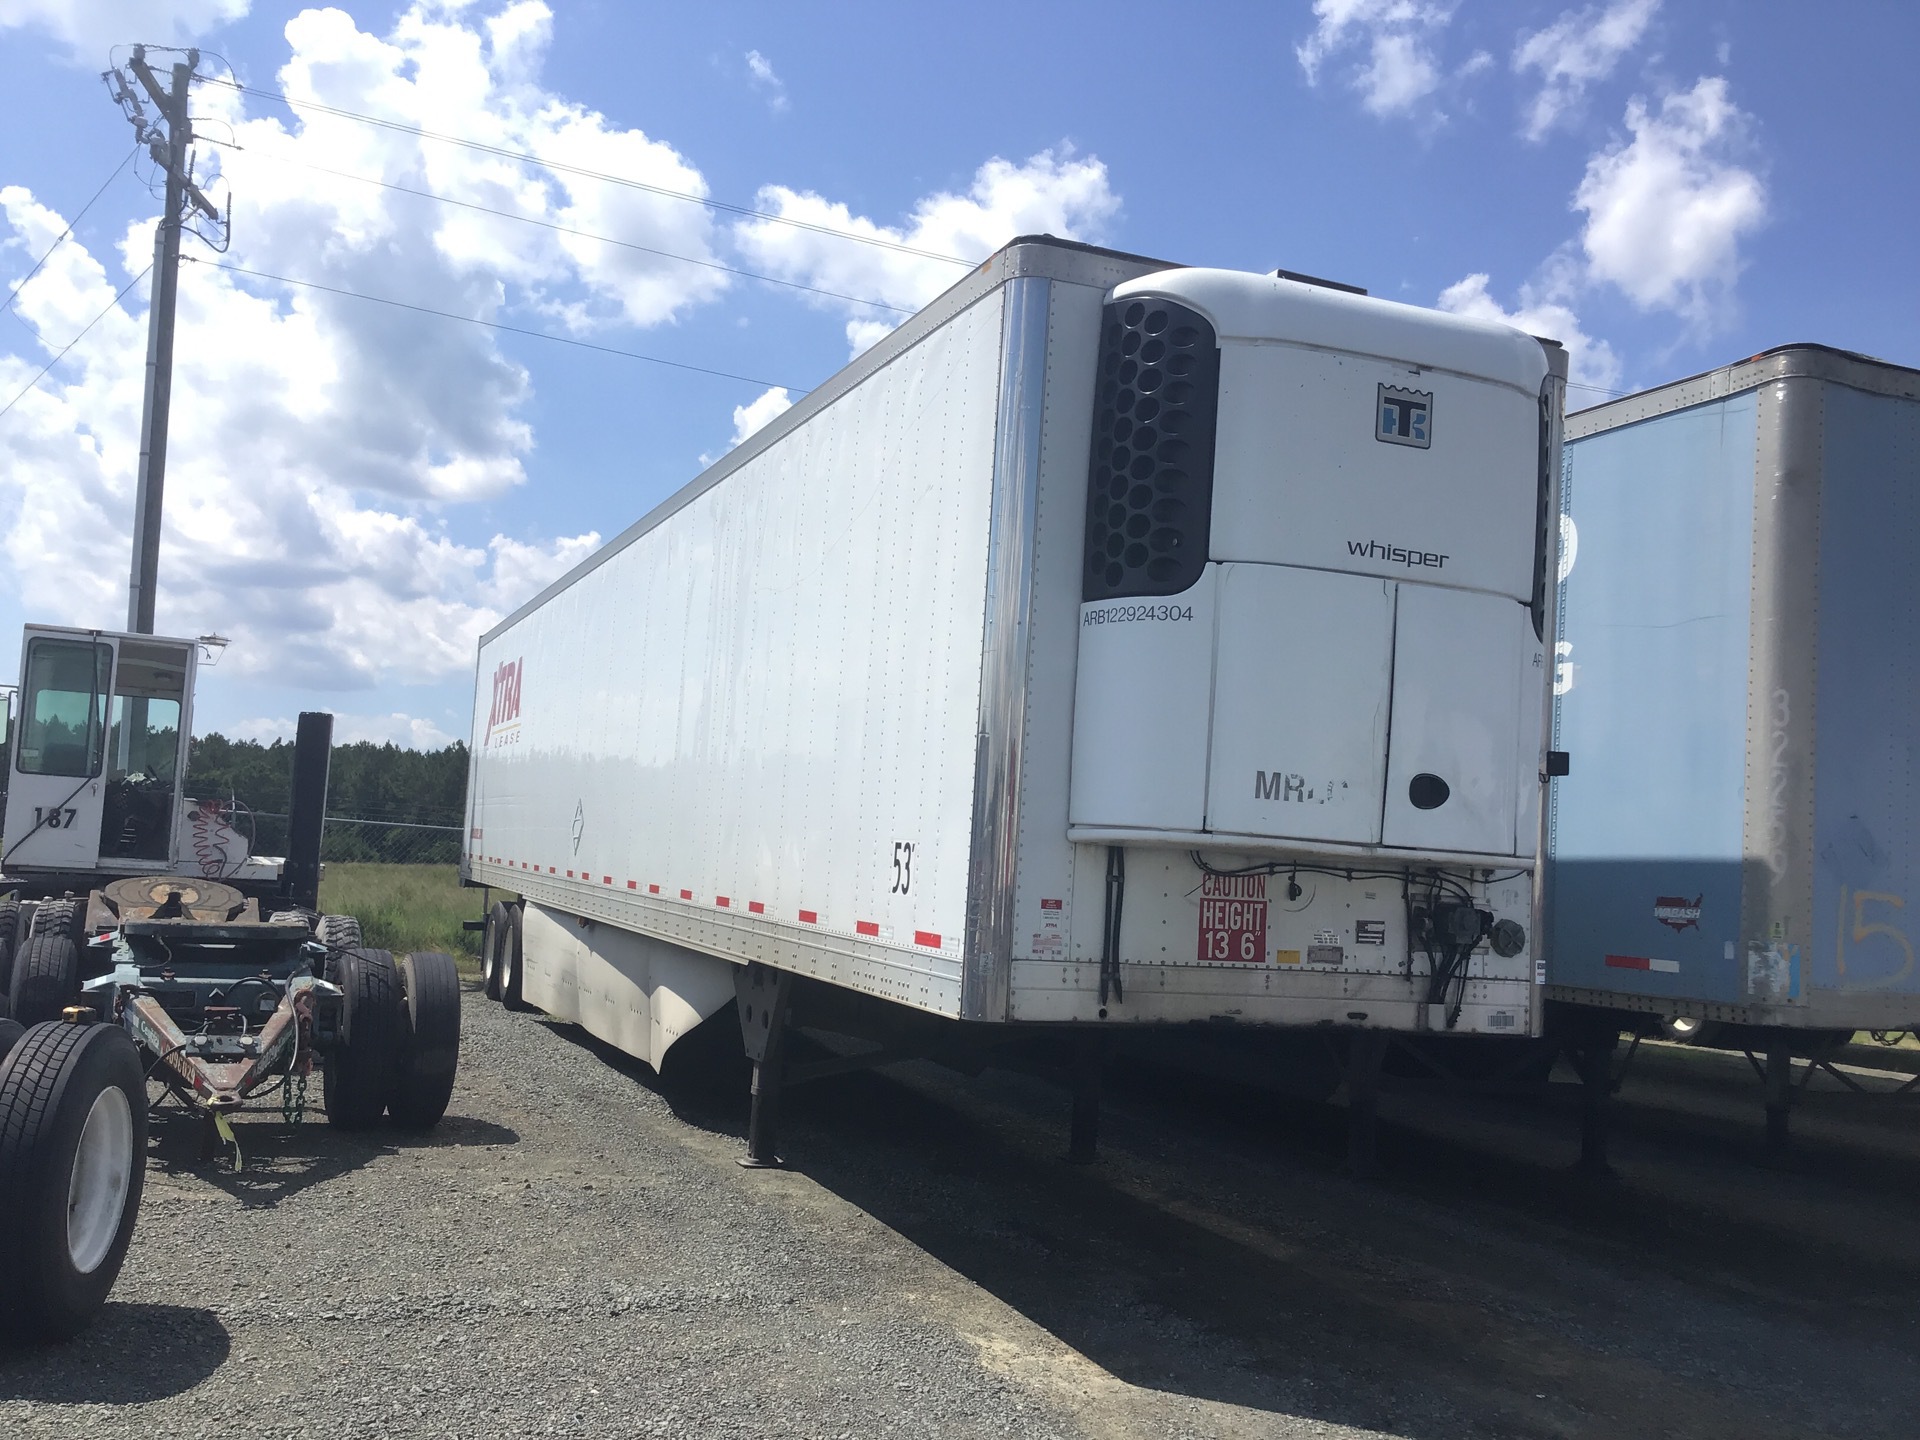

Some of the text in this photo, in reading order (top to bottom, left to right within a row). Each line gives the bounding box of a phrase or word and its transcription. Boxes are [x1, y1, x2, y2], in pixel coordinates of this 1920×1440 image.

[1347, 540, 1450, 568] whisper
[1082, 604, 1194, 627] ARB122924304
[484, 656, 523, 746] XTRA
[494, 731, 521, 749] LEASE
[35, 807, 77, 829] 187
[1202, 872, 1266, 899] CAUTION
[1203, 901, 1264, 931] HEIGHT
[1654, 907, 1701, 919] WABASH
[1836, 883, 1915, 990] 15
